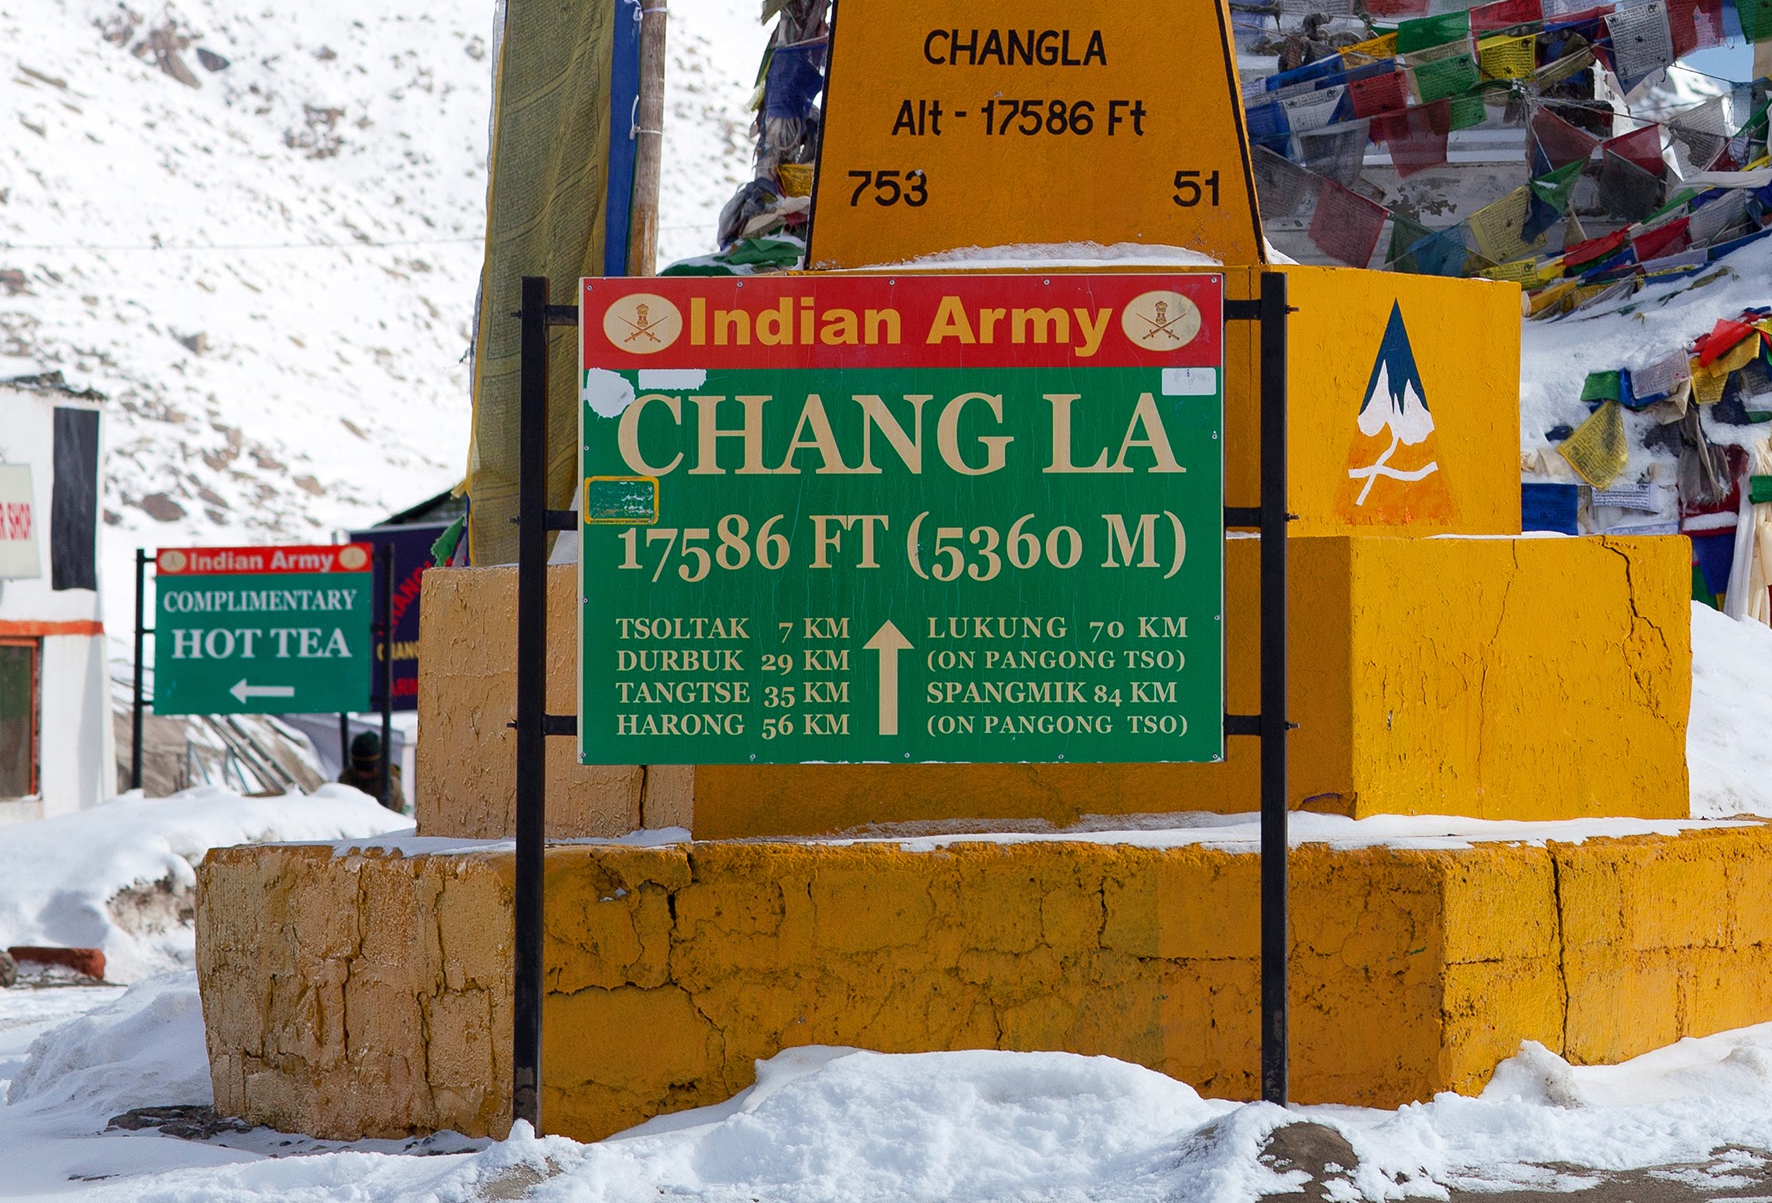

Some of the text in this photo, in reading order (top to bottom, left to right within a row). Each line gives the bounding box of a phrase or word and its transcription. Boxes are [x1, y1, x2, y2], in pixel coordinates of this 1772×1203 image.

[924, 29, 1107, 66] CHANGLA
[892, 100, 942, 136] Alt
[981, 100, 1094, 135] 17586
[1108, 100, 1146, 136] Ft
[848, 170, 928, 207] 753
[1173, 170, 1219, 207] 51
[691, 296, 1112, 356] Indian Army
[617, 391, 1186, 475] CHANG LA
[7, 502, 32, 540] SHOP
[617, 510, 1186, 583] 17586 FT (5360 M)
[189, 550, 335, 573] Indian Army
[164, 589, 357, 613] COMPLIMENTARY
[172, 627, 352, 660] HOT TEA
[616, 617, 850, 645] TSOLTAK 7 KM
[927, 616, 1189, 645] LUKUNG 70 KM
[616, 649, 850, 677] DURBUK 29 KM
[926, 648, 1186, 672] (ON PANGONG TSO)
[616, 681, 850, 709] TANGTSE 35 KM
[926, 680, 1177, 707] SPANGMIK 84 KM
[616, 713, 850, 741] HARONG 56 KM
[926, 713, 1188, 737] (ON PANGONG TSO)
